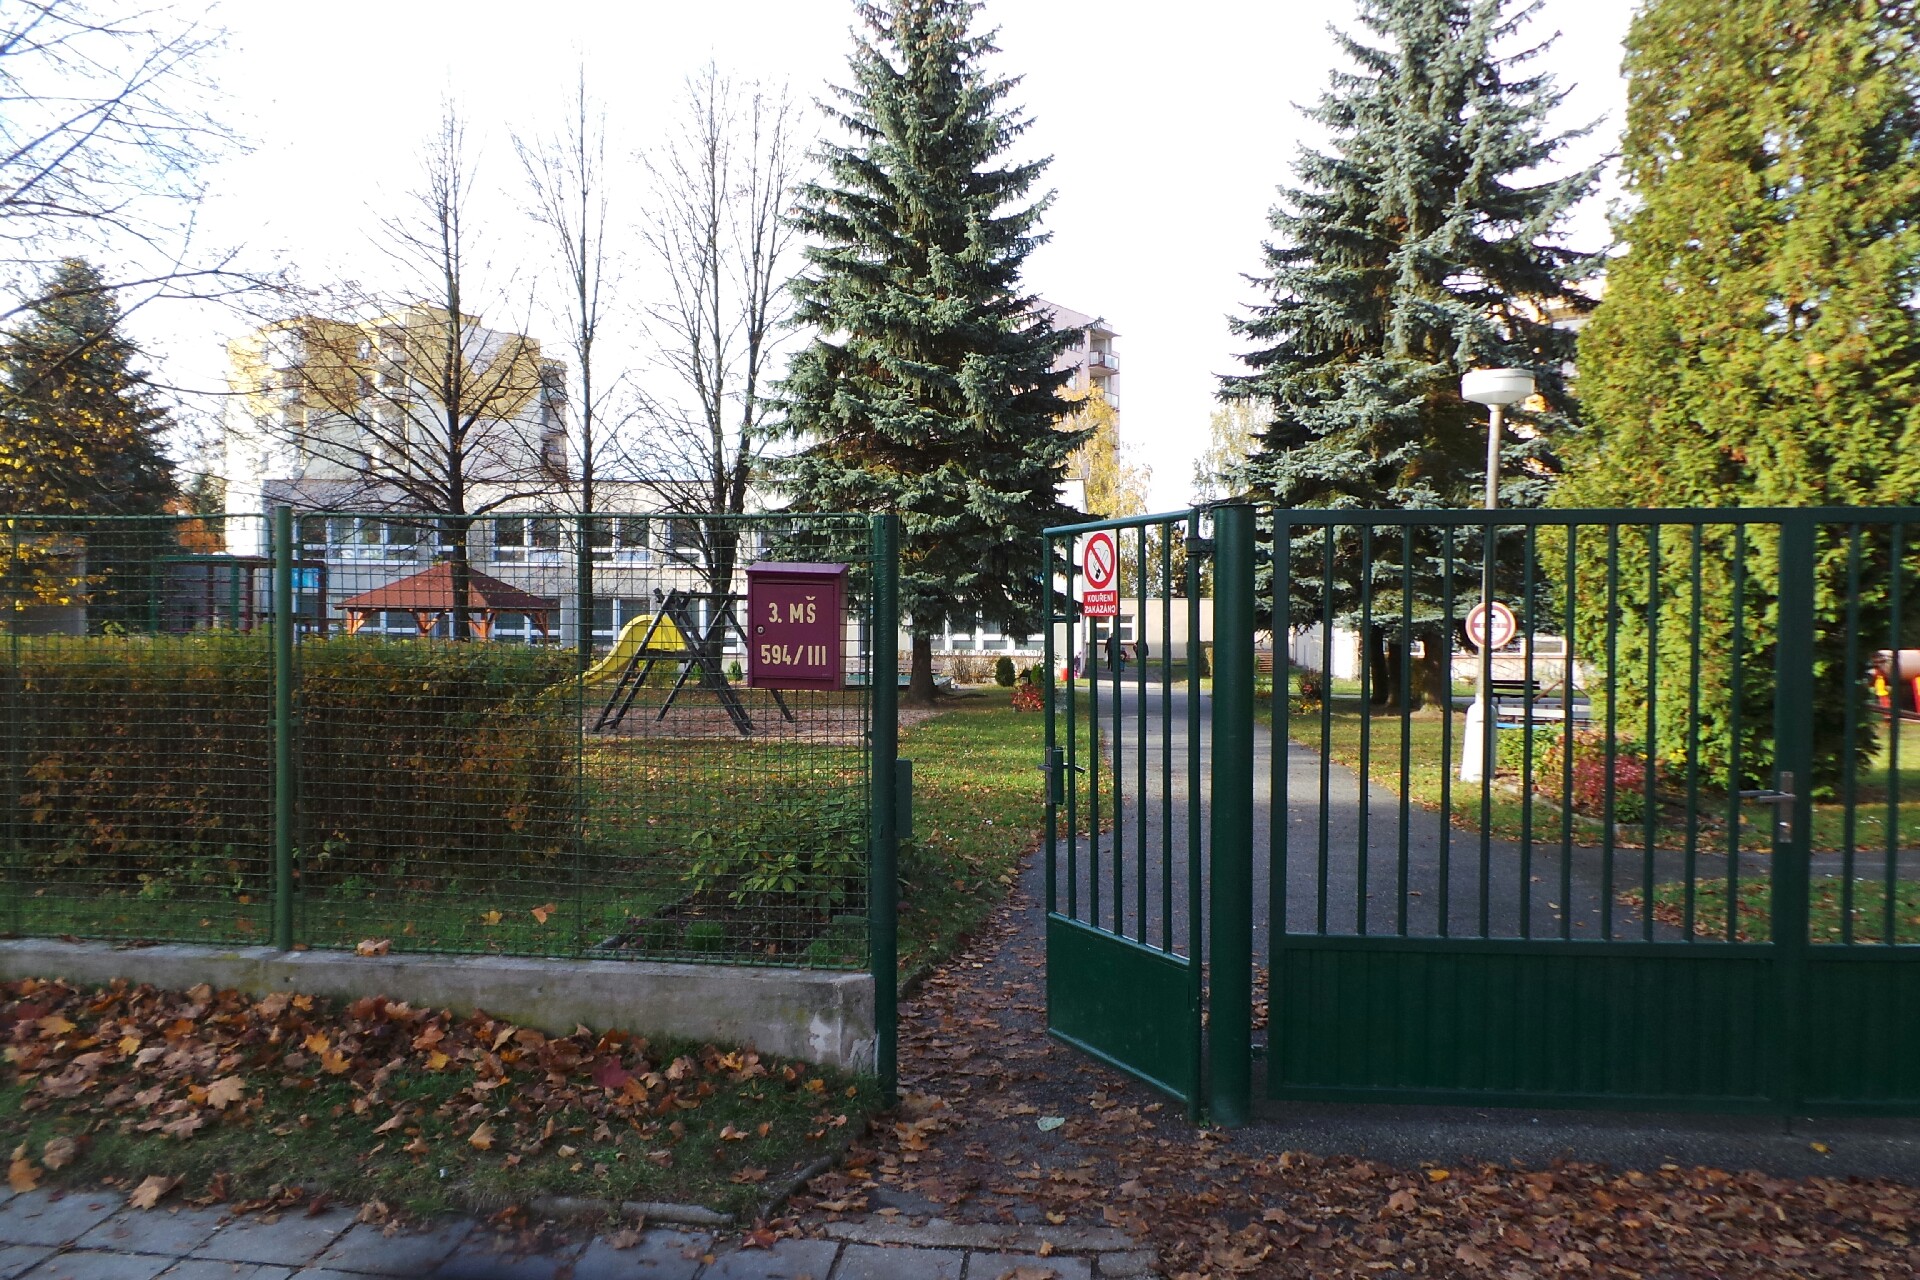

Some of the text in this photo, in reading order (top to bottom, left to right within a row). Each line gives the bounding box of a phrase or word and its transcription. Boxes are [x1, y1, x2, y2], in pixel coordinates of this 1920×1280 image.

[1087, 592, 1113, 602] KOUŘENÍ
[768, 595, 816, 623] 3. MŠ
[1084, 604, 1116, 614] ZAKÁZÁNO
